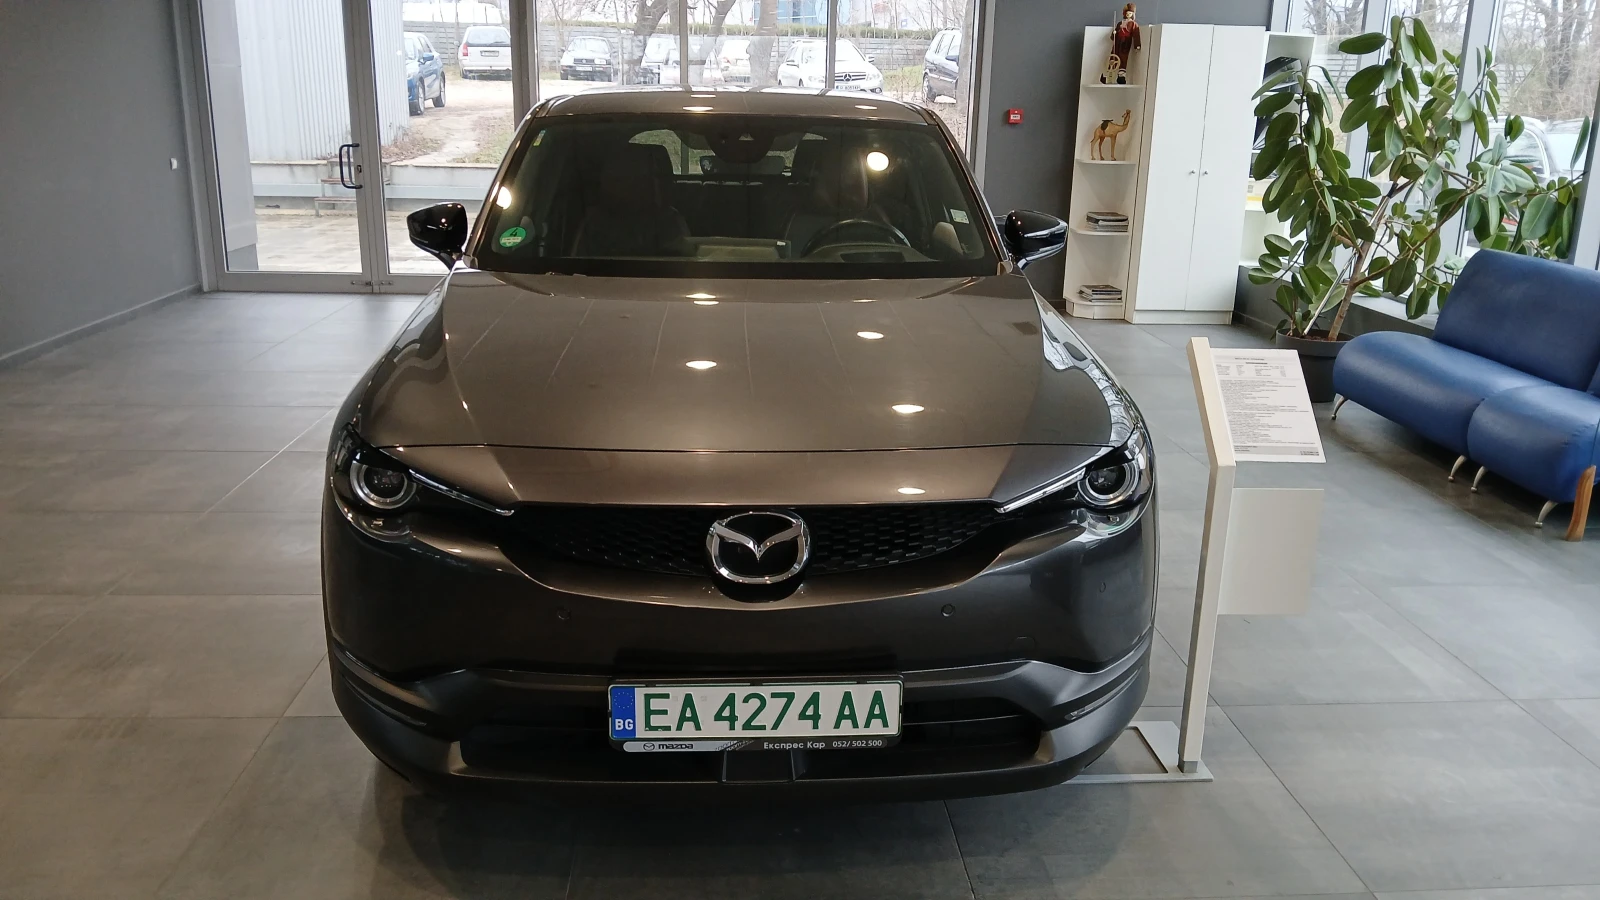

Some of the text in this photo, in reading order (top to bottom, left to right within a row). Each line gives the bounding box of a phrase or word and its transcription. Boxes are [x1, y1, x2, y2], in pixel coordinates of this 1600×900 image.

[510, 228, 518, 237] 4
[644, 690, 889, 732] EA 4274 AA
[615, 718, 634, 731] BG
[763, 741, 804, 750] Експрес
[807, 741, 826, 750] Кар
[868, 739, 883, 747] 500
